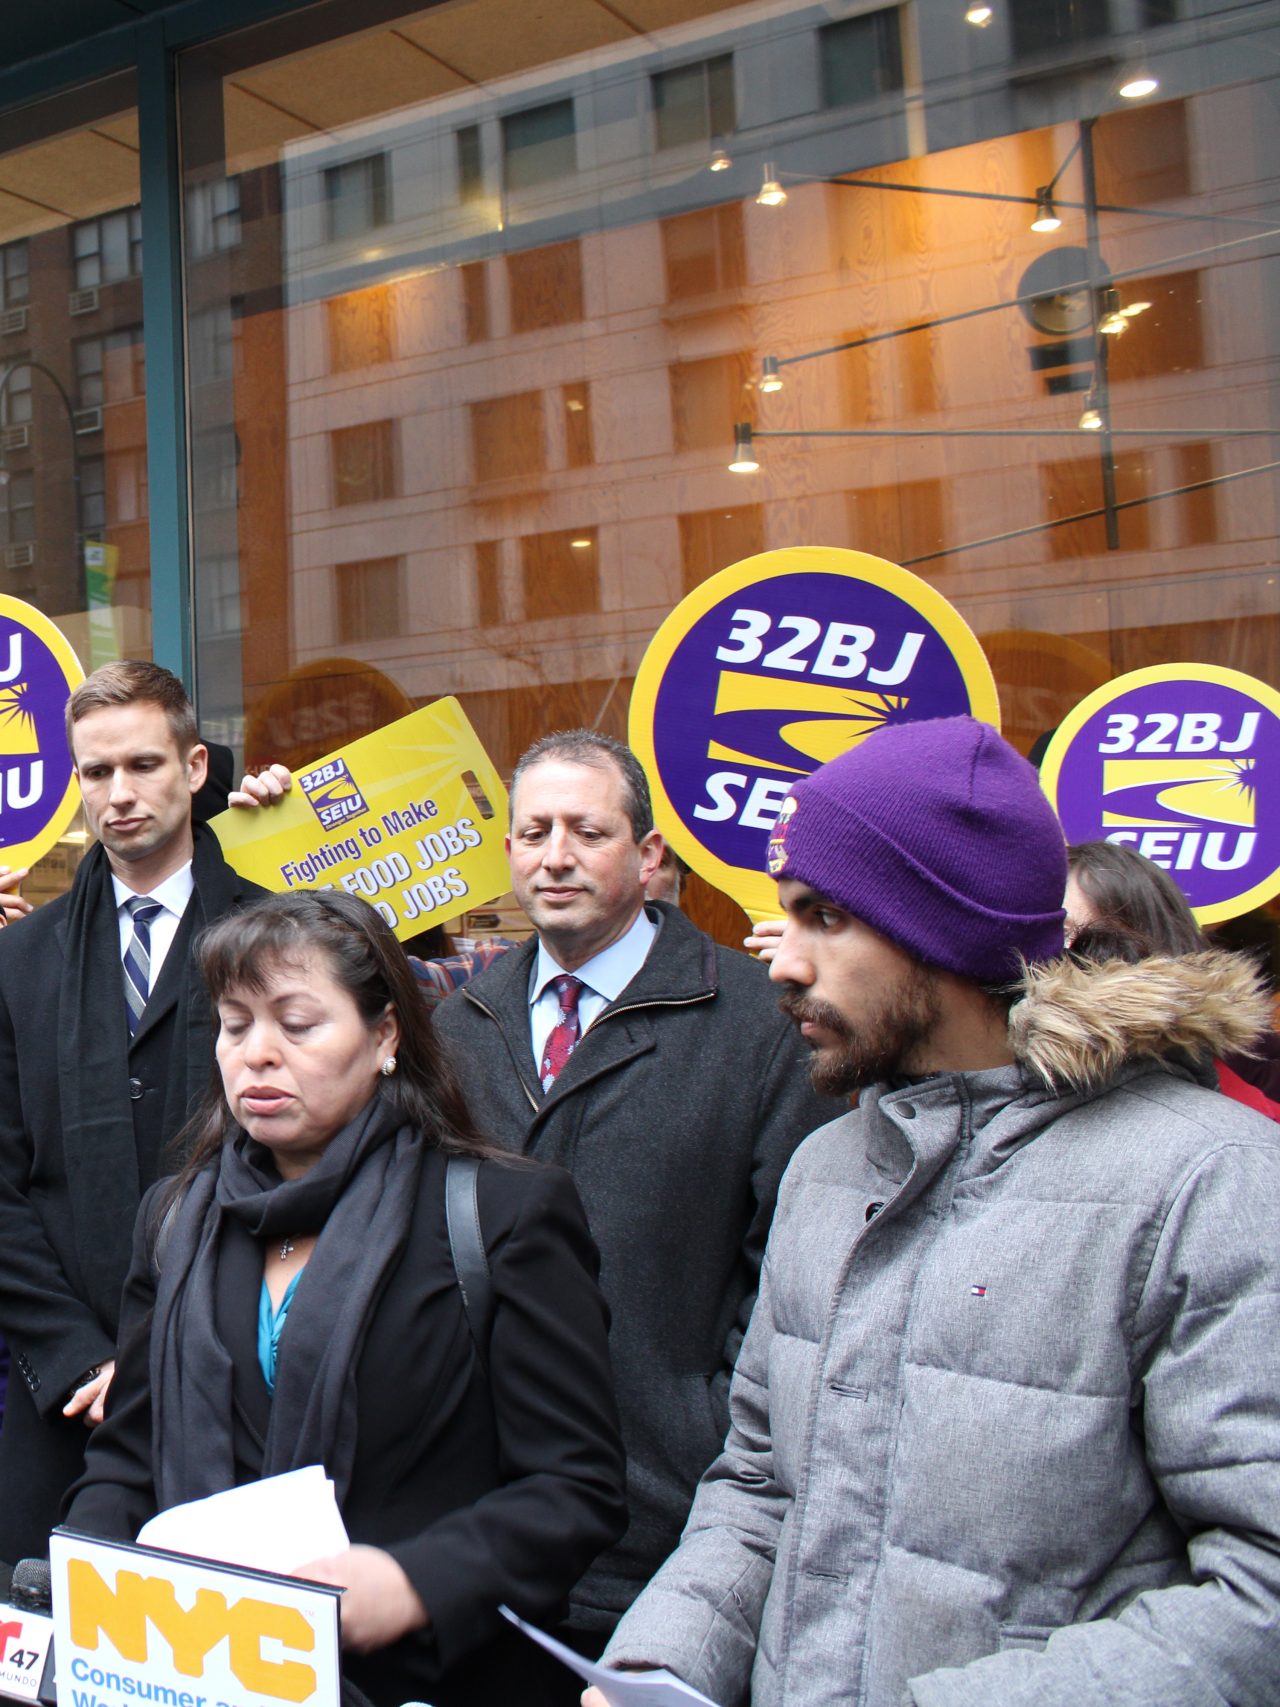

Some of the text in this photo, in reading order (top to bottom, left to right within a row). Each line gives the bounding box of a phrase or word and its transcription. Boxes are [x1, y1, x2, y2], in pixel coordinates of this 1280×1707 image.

[716, 609, 926, 686] 32BJ
[1098, 712, 1261, 753] 32BJ
[301, 758, 345, 793] 32BJ
[693, 771, 794, 831] SE
[320, 794, 362, 825] SEIU
[280, 836, 362, 886] Fighting
[359, 827, 382, 848] to
[381, 799, 438, 837] Make
[340, 852, 411, 896] FOOD
[415, 818, 482, 870] JOBS
[402, 868, 468, 919] JOBS
[68, 1558, 317, 1704] NYC
[9, 1649, 40, 1670] 47
[71, 1657, 208, 1707] Consumer
